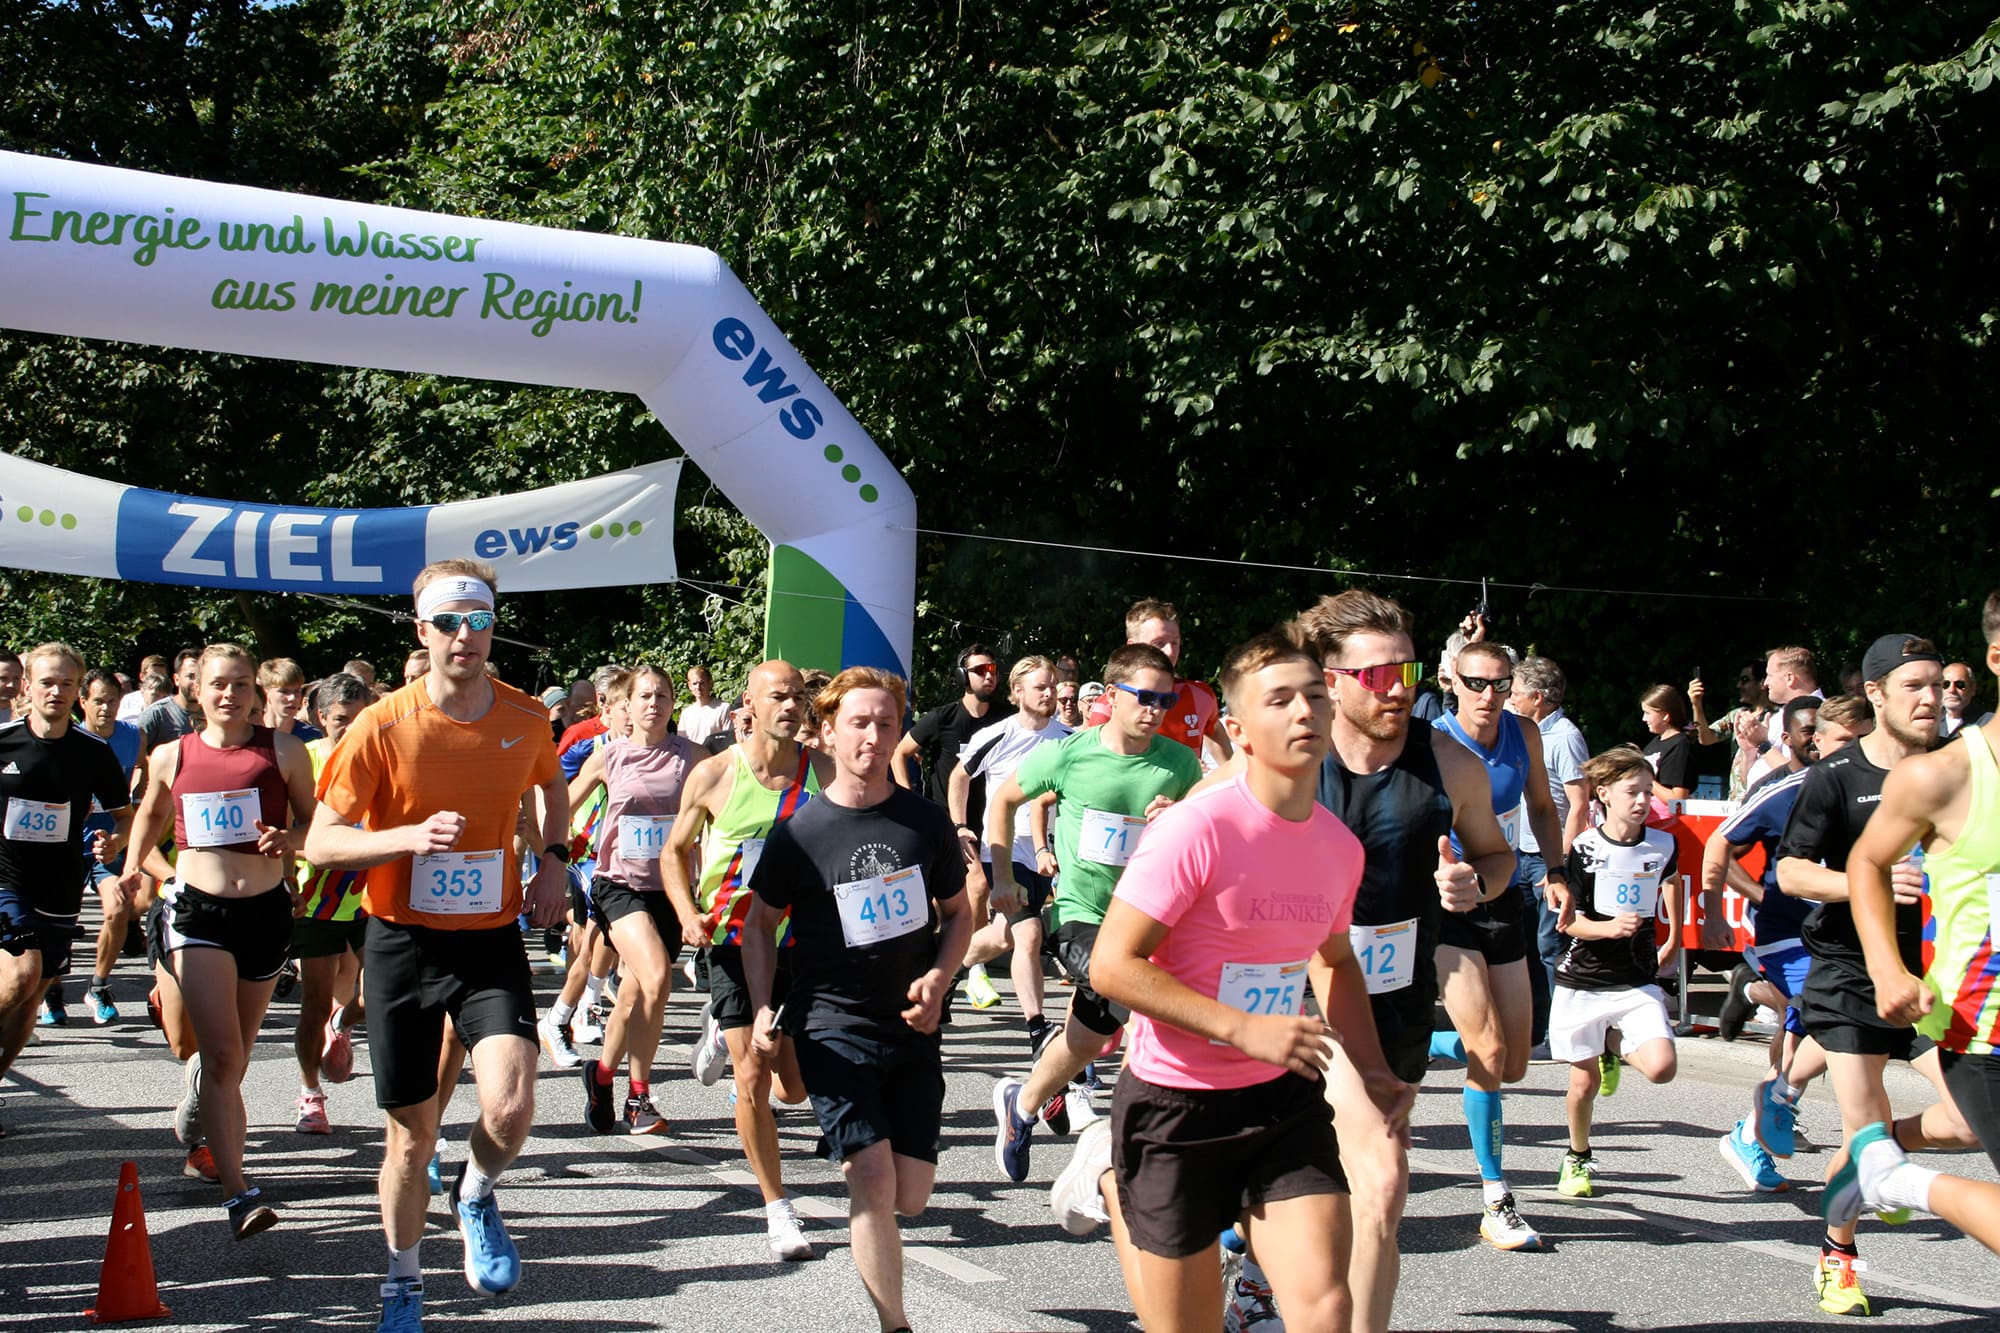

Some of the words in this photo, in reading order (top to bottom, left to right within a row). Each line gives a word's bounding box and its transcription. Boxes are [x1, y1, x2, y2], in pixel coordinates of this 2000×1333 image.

[10, 192, 210, 266] Energie
[218, 215, 315, 255] und
[324, 216, 484, 263] Wasser
[212, 278, 296, 312] aus
[310, 275, 469, 319] meiner
[480, 272, 643, 338] Region!
[712, 316, 824, 441] ews
[162, 502, 384, 583] ZIEL
[474, 520, 580, 559] ews
[18, 811, 58, 832] 436
[200, 804, 244, 832] 140
[633, 826, 663, 847] 111
[1104, 827, 1129, 852] 71
[430, 868, 483, 897] 353
[1616, 883, 1641, 905] 83
[860, 888, 910, 924] 413
[1243, 985, 1296, 1014] 275
